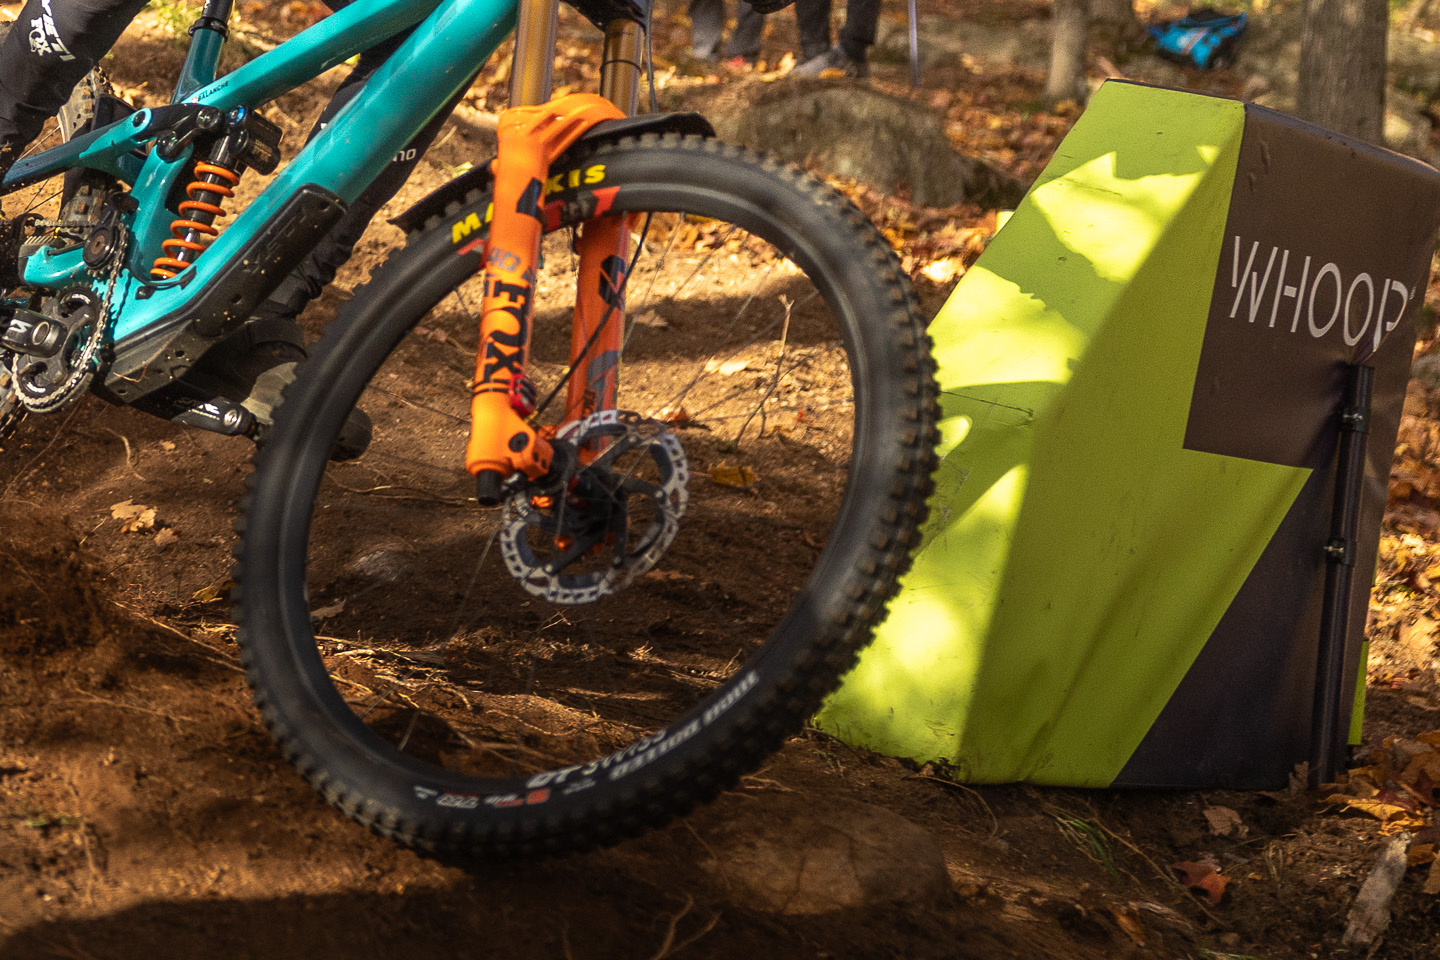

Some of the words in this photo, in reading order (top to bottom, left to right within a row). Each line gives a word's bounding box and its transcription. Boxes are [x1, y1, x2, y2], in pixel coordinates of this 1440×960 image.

[29, 16, 52, 56] FOX
[483, 276, 532, 383] FOX
[1229, 235, 1409, 353] WHOOP
